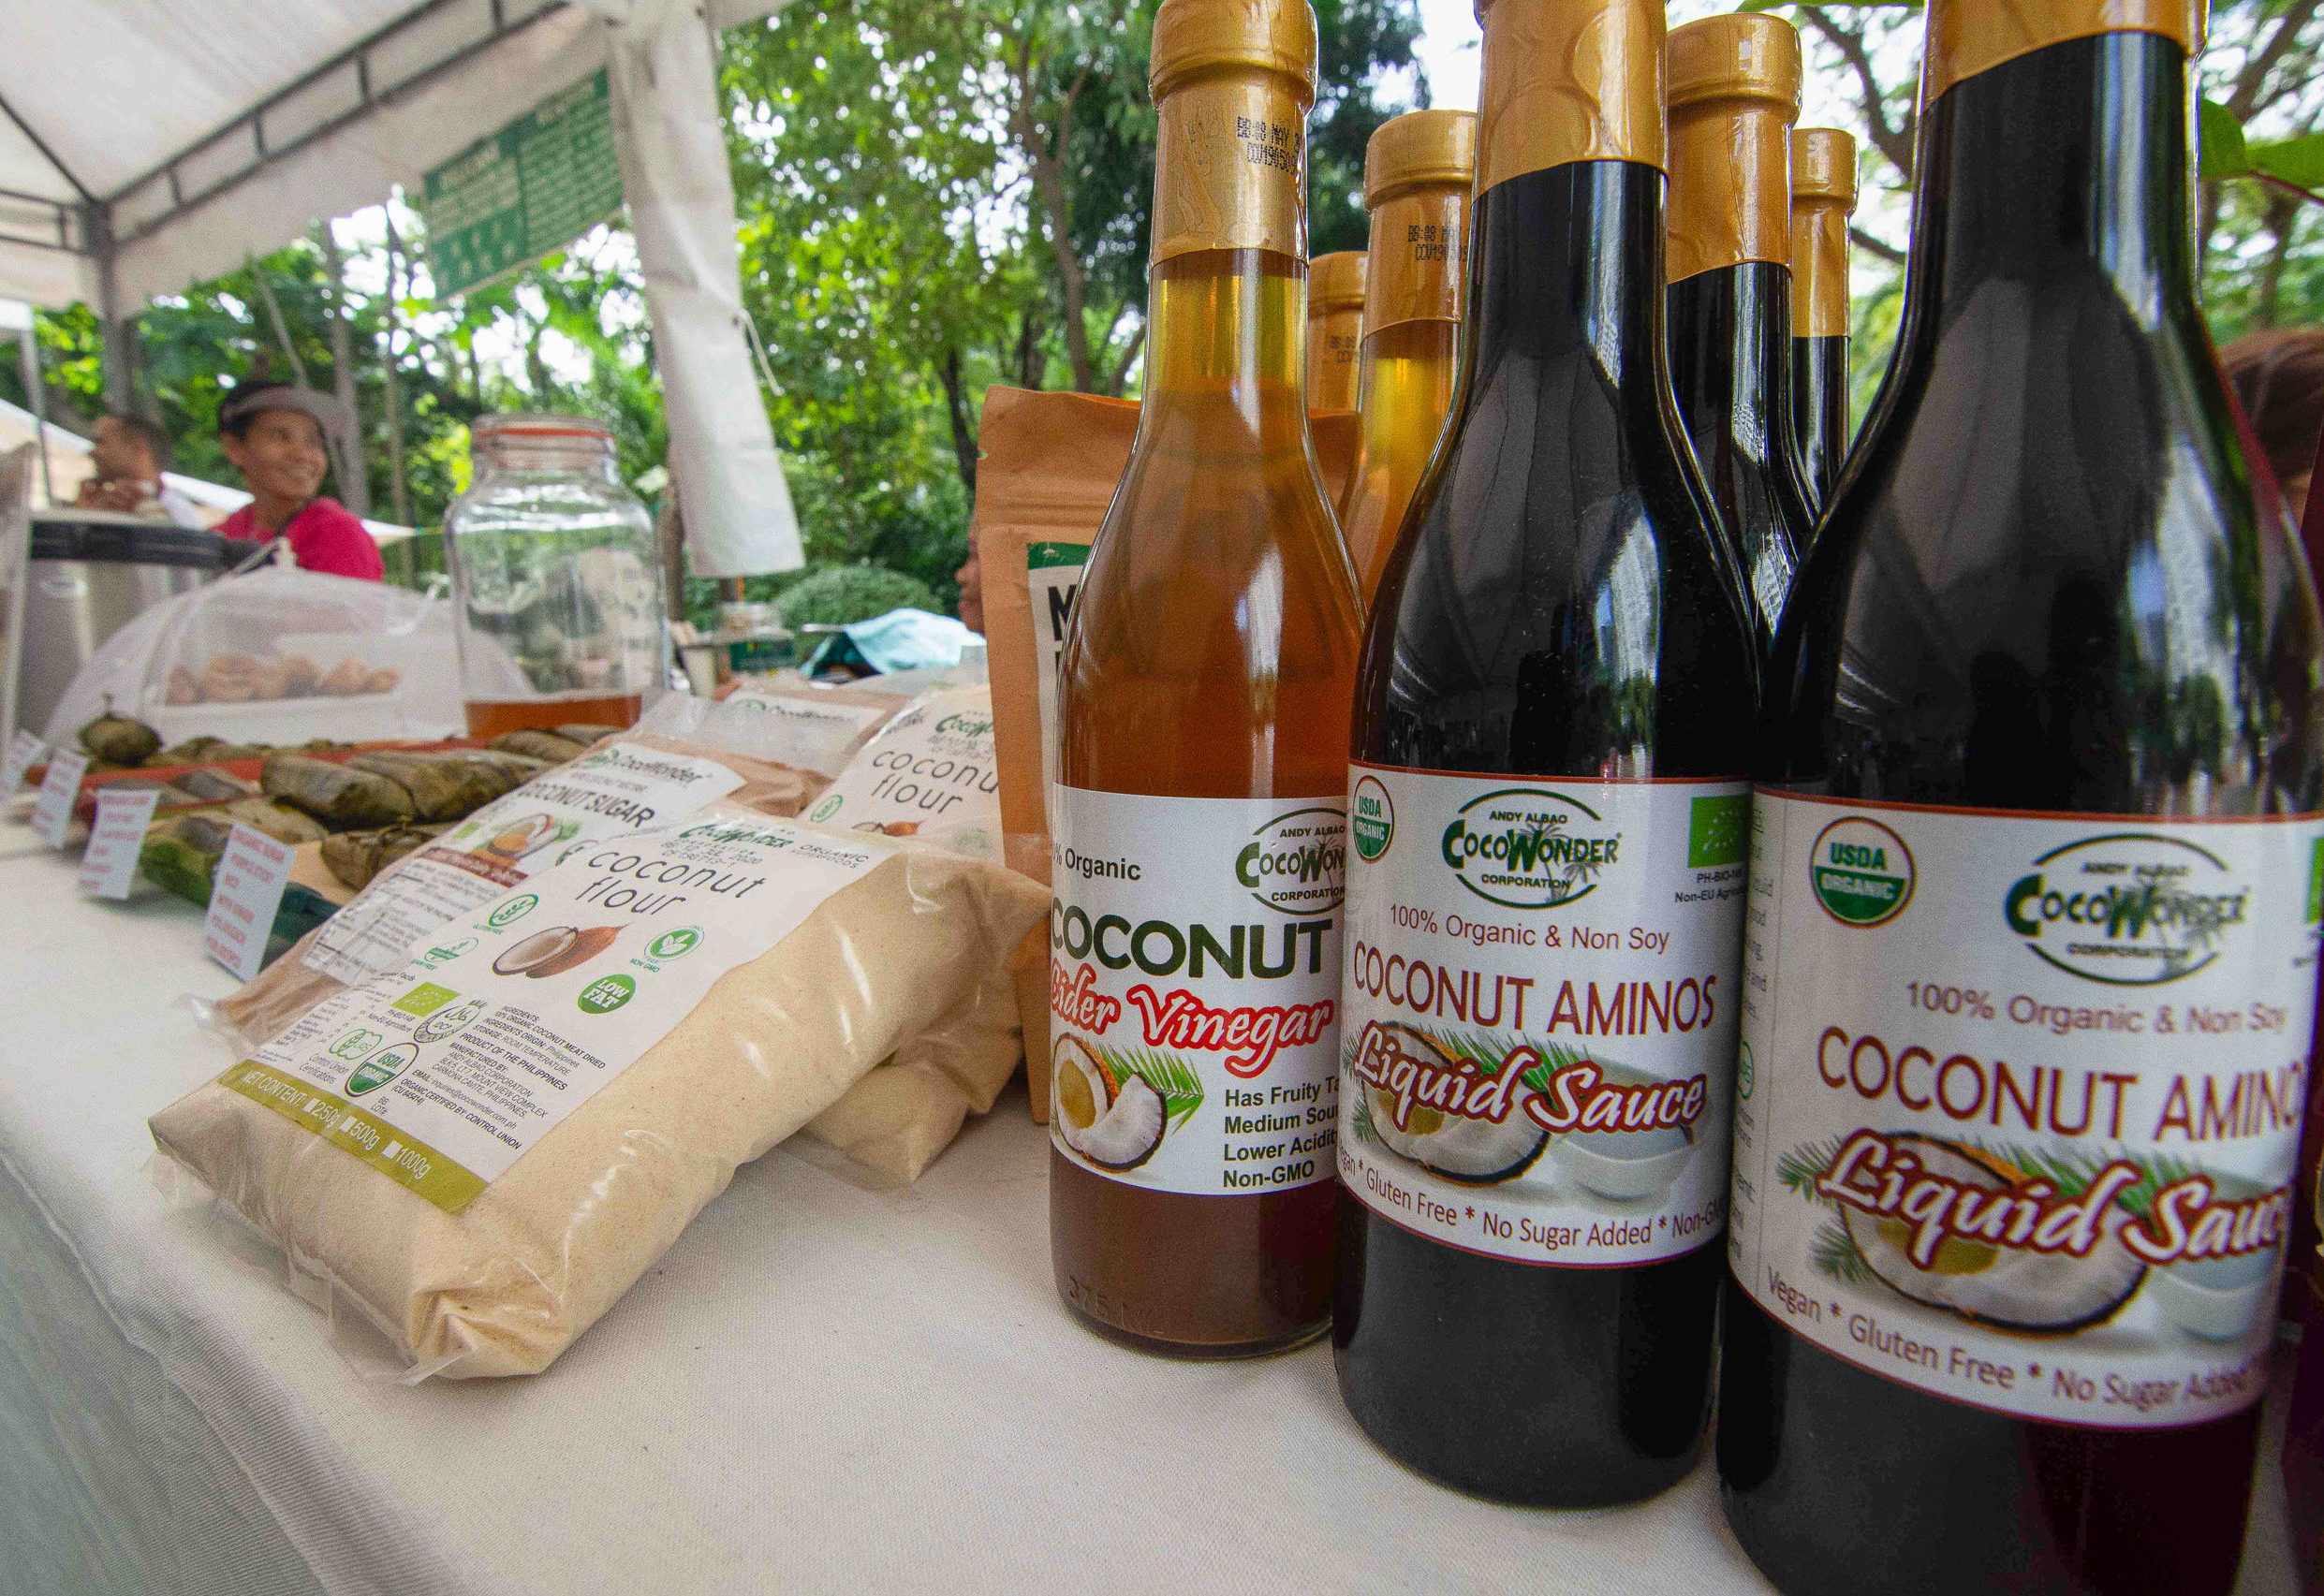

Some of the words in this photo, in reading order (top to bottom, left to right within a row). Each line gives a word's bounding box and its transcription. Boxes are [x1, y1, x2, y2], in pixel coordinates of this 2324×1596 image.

[583, 794, 655, 828] SUGAR
[871, 773, 963, 813] flour
[1359, 795, 1382, 818] USDA
[1279, 827, 1312, 839] ANDY
[1314, 825, 1346, 837] ALBAO
[1356, 820, 1387, 841] ORGANIC
[1489, 811, 1522, 823] ANDY
[1525, 812, 1568, 824] ALBAO
[1065, 847, 1141, 881] Organic
[1829, 842, 1889, 871] USDA
[587, 852, 766, 899] coconut
[1481, 873, 1571, 889] CORPORATION
[1822, 872, 1899, 900] ORGANIC
[575, 876, 686, 915] flour
[1675, 888, 1714, 902] Non-EU
[1052, 897, 1333, 979] COCONUT
[1390, 903, 1438, 934] 100%
[1446, 915, 1537, 946] Organic
[1545, 925, 1560, 948] &
[1571, 926, 1620, 950] Non
[1628, 928, 1670, 954] Soy
[582, 990, 620, 1009] FAT
[599, 979, 630, 998] LOW
[1354, 940, 1535, 1031] COCONUT
[1546, 974, 1718, 1036] AMINOS
[1906, 981, 1996, 1022] 100%
[2008, 995, 2144, 1035] Organic
[2156, 1003, 2177, 1033] &
[2187, 1005, 2244, 1033] Non
[483, 1018, 522, 1040] INGREDIENTS
[521, 1032, 548, 1050] ORIGIN:
[545, 1046, 581, 1068] Philippines
[501, 1036, 522, 1049] ROOM
[507, 1013, 536, 1030] ORGANIC
[532, 1025, 567, 1046] COCONUT
[564, 1042, 586, 1057] MEAT
[582, 1052, 607, 1070] DRIED
[1126, 984, 1334, 1078] Vinegar
[376, 1051, 405, 1069] USDA
[432, 1063, 463, 1083] CARMONA
[449, 1042, 498, 1068] MANUFACTURED
[460, 1032, 495, 1051] PRODUCT
[491, 1046, 506, 1056] OF
[502, 1051, 521, 1064] THE
[517, 1059, 567, 1091] PHILIPPINES
[449, 1051, 470, 1064] ANDY
[466, 1059, 486, 1073] ALBAO
[483, 1067, 534, 1098] CORPORATION
[1353, 1019, 1543, 1133] Liquid
[1522, 1060, 1708, 1135] Sauce
[1817, 1025, 2140, 1141] COCONUT
[471, 1072, 497, 1088] MOUNT
[494, 1084, 513, 1099] VIEW
[511, 1094, 550, 1120] COMPLEX
[1225, 1090, 1264, 1108] Has
[1271, 1079, 1322, 1105] Fruity
[257, 1074, 308, 1106] CONTENT
[349, 1120, 382, 1151] 500g
[394, 1147, 433, 1180] 1000g
[401, 1078, 430, 1095] ORGANIC
[425, 1090, 459, 1111] CERTIFIED
[465, 1113, 495, 1136] CONTROL
[496, 1131, 522, 1149] UNION
[1225, 1113, 1301, 1135] Medium
[1224, 1140, 1286, 1162] Lower
[1223, 1160, 1315, 1188] Non-GMO
[1366, 1167, 1412, 1211] Gluten
[1417, 1192, 1458, 1227] Free
[1483, 1211, 1513, 1238] No
[1520, 1218, 1581, 1251] Sugar
[1586, 1219, 1653, 1247] Added
[1816, 1127, 2144, 1271] Liquid
[1768, 1265, 1822, 1325] Vegan
[1848, 1313, 1939, 1371] Gluten
[1948, 1346, 2016, 1391] Free
[2052, 1369, 2096, 1402] No
[2104, 1373, 2183, 1413] Sugar
